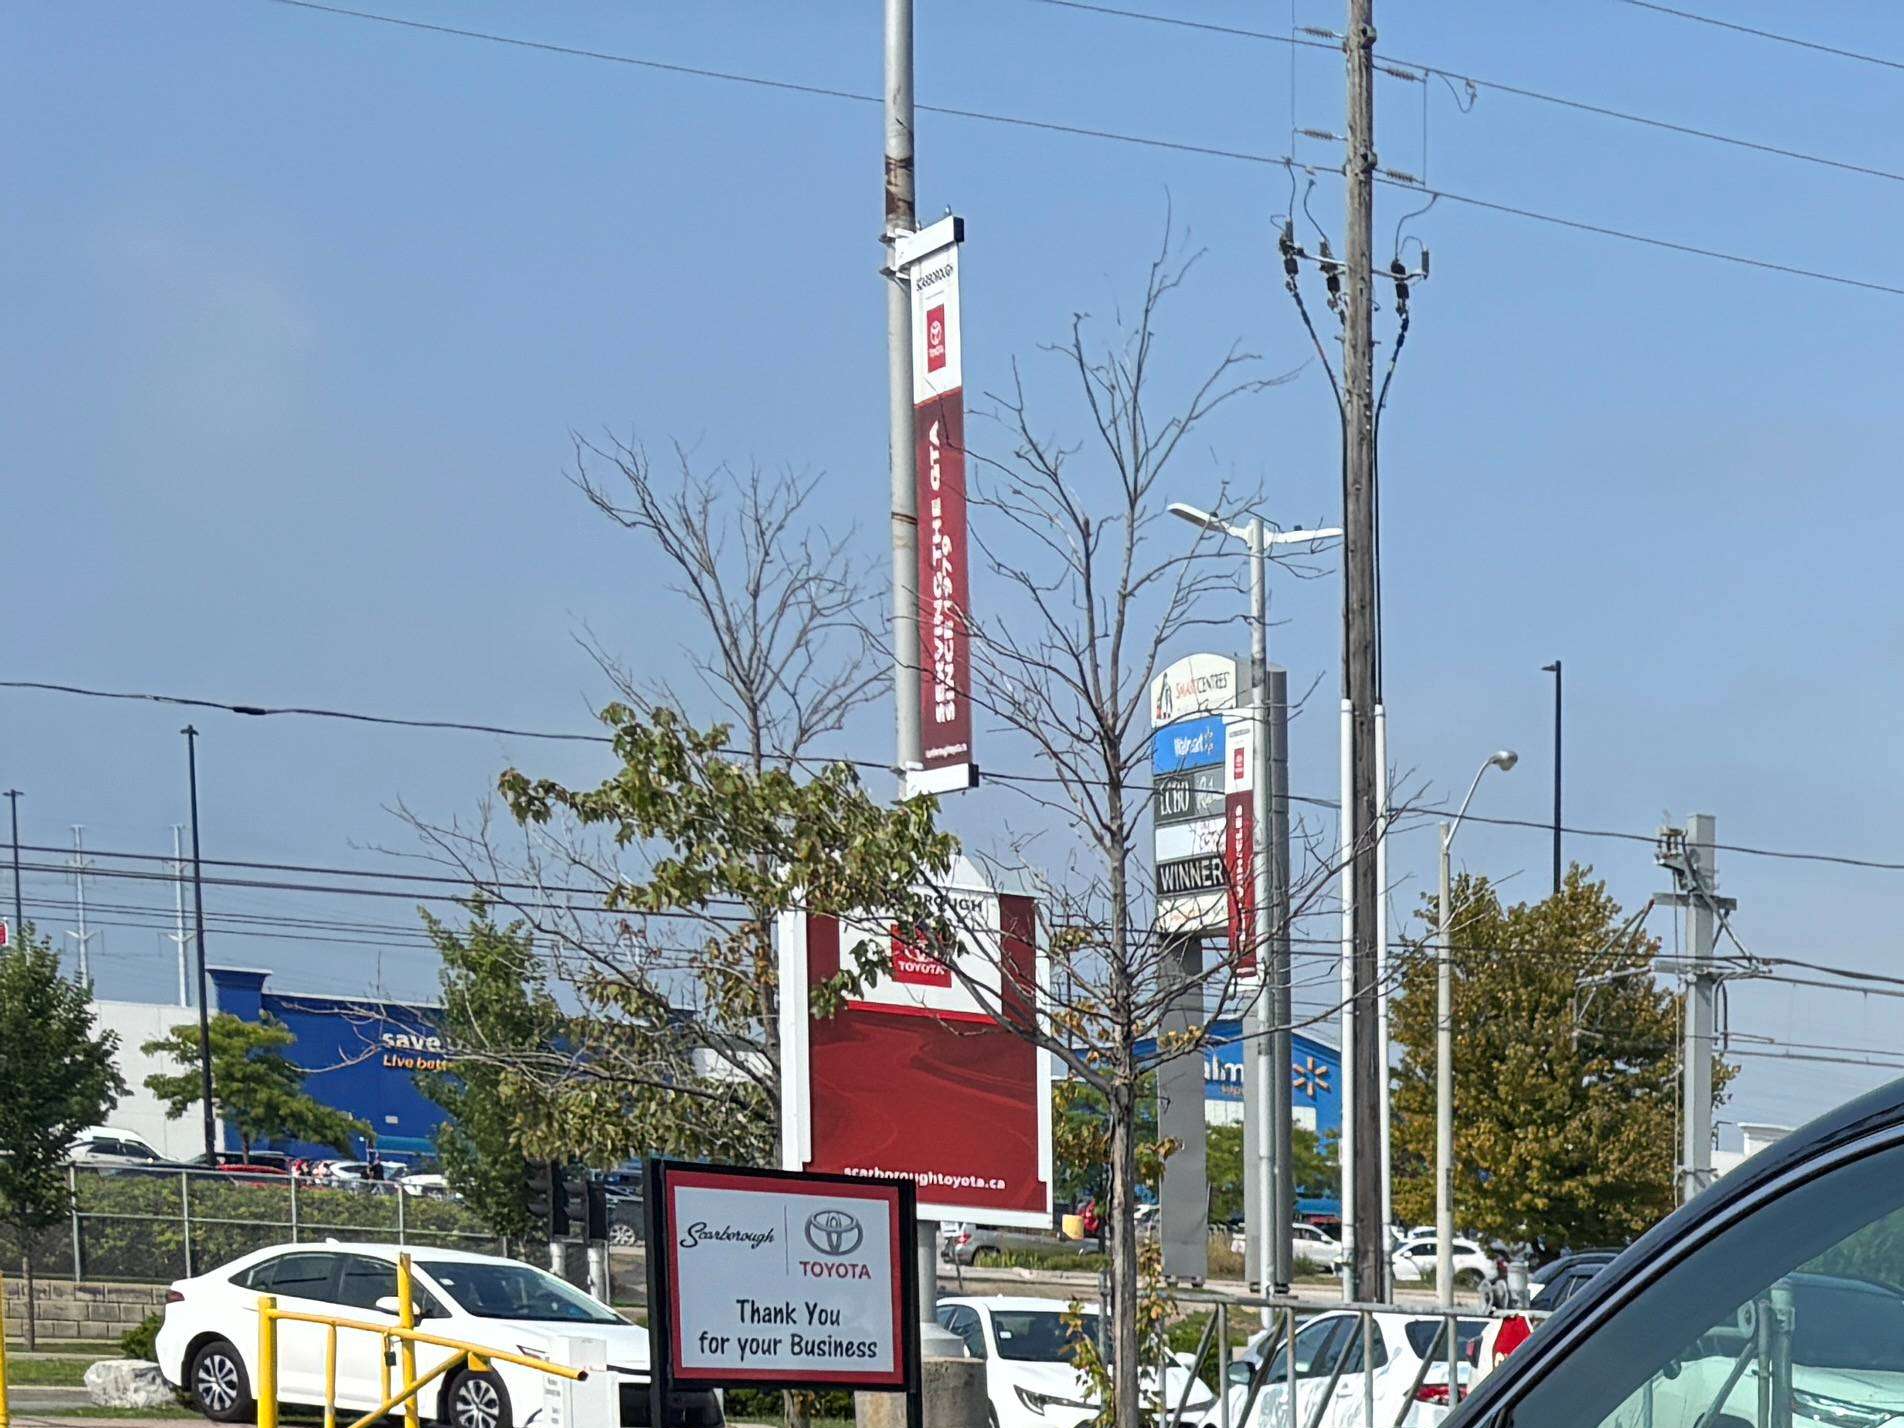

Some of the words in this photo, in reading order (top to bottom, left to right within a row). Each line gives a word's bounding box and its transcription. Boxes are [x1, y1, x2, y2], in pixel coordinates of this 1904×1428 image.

[929, 420, 940, 491] GTA
[931, 497, 942, 568] THE
[932, 571, 946, 723] SERVING
[943, 620, 956, 722] SINCE
[1160, 857, 1224, 891] WINNER
[899, 960, 946, 976] TOYOTA
[382, 1033, 447, 1053] save
[680, 1221, 775, 1250] Scarborough
[799, 1260, 872, 1280] TOYOTA
[736, 1299, 797, 1326] Thank
[804, 1301, 841, 1327] You
[698, 1331, 730, 1355] for
[737, 1336, 783, 1363] your
[790, 1332, 878, 1359] Business
